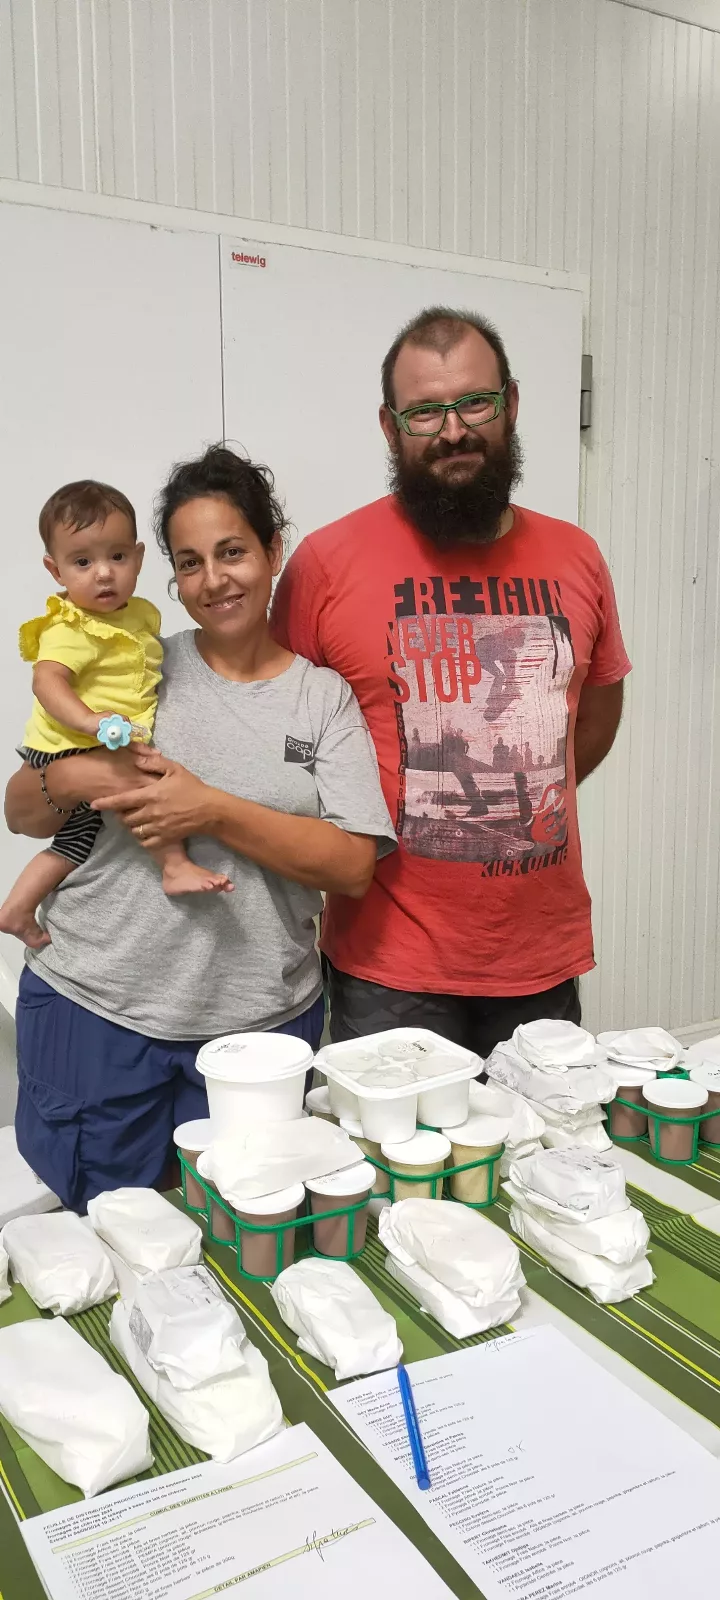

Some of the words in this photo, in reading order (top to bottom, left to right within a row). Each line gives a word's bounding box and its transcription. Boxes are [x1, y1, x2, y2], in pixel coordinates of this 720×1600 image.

[231, 251, 266, 268] telewig
[386, 617, 476, 655] NEVER
[386, 651, 481, 704] STOP
[481, 859, 522, 878] KICK
